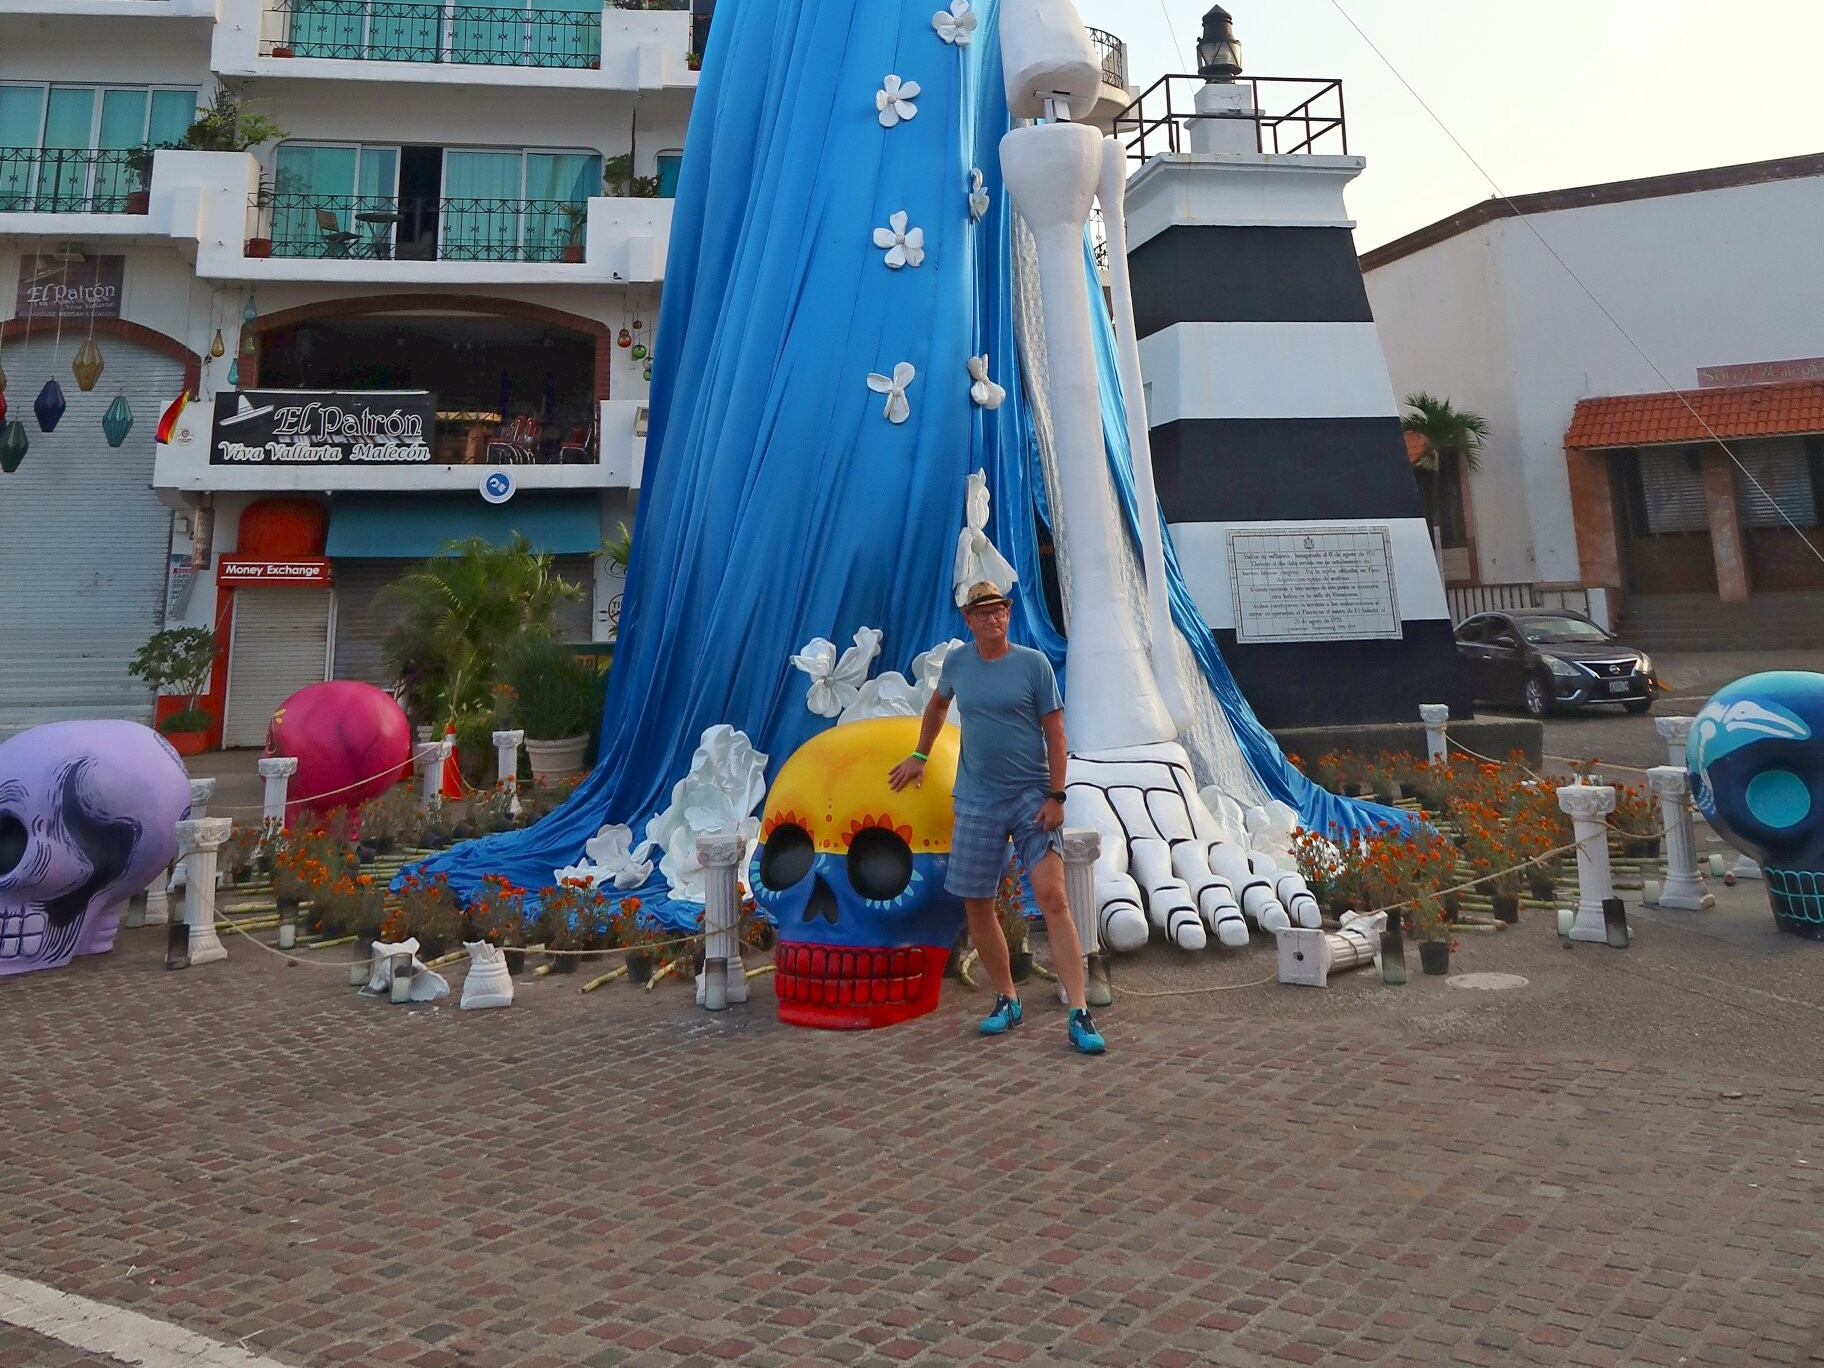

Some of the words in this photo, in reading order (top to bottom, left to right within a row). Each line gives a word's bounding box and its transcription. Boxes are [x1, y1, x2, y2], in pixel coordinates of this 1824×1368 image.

[27, 283, 55, 303] El
[54, 282, 115, 304] Patrón
[272, 401, 321, 435] El
[318, 406, 423, 441] Patrón
[218, 440, 265, 461] Viva
[265, 440, 342, 461] Vallarta
[349, 442, 431, 461] Malecón
[225, 564, 264, 576] Money
[266, 565, 320, 577] Exchange
